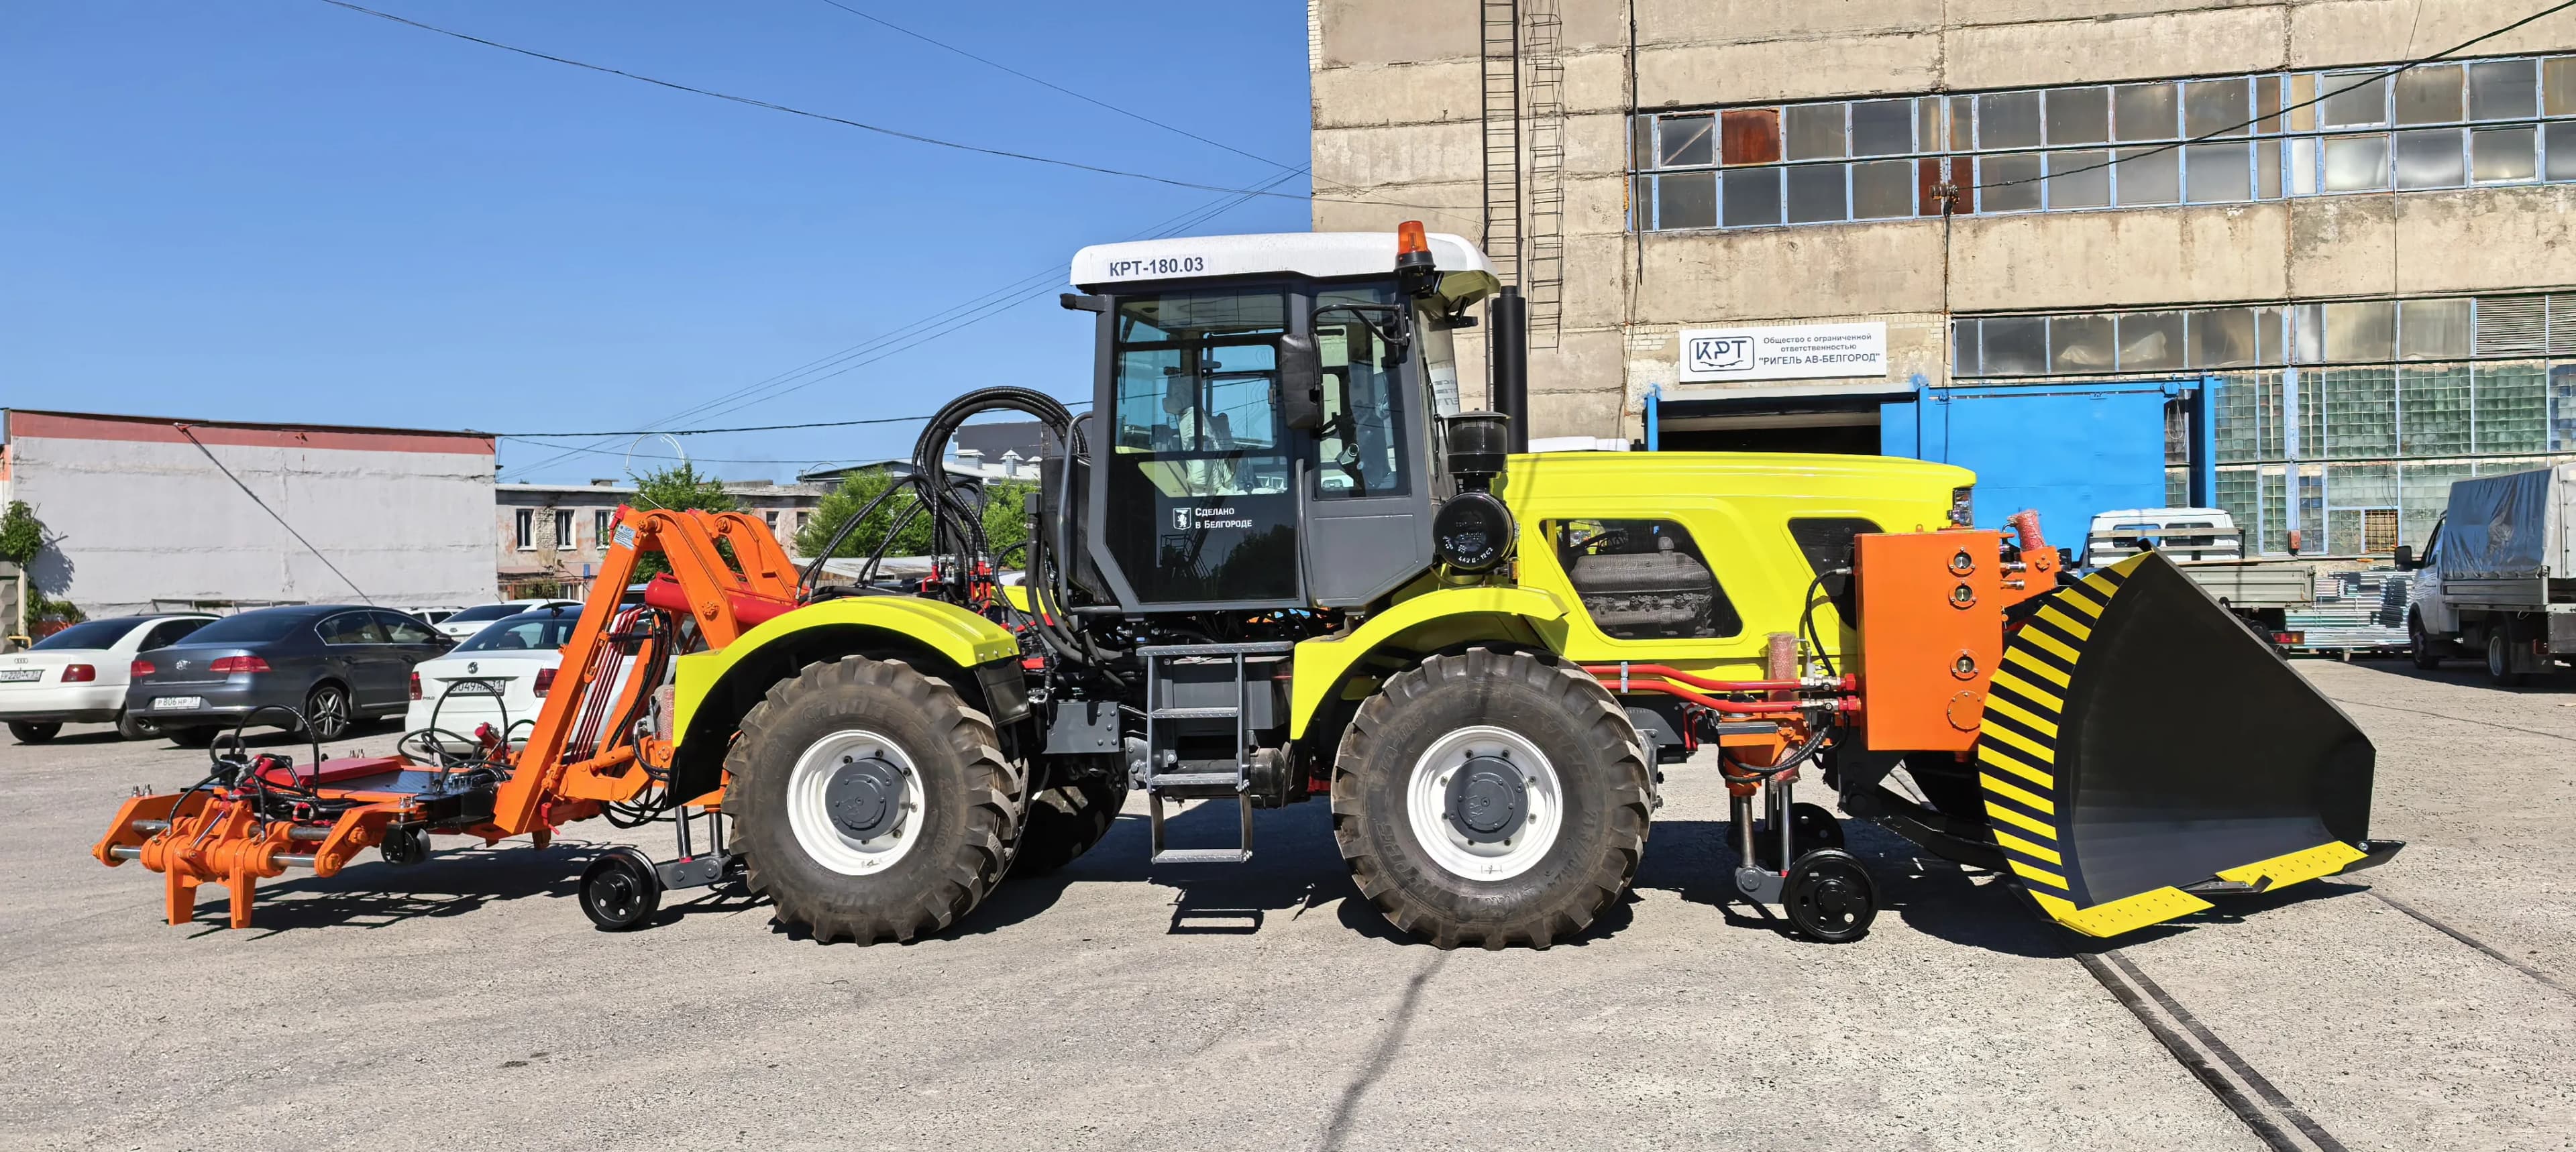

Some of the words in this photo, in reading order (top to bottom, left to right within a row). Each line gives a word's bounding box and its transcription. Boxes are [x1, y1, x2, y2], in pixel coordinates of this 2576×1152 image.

[1110, 257, 1204, 276] КРТ-180.03
[1763, 336, 1805, 344] Общество
[1813, 333, 1872, 343] ограниченной
[1696, 340, 1748, 360] КРТ
[1780, 343, 1857, 352] ответственностью
[1758, 355, 1803, 365] "РИГЕЛЬ
[1805, 353, 1880, 363] АВ-БЕЛГОРОД"
